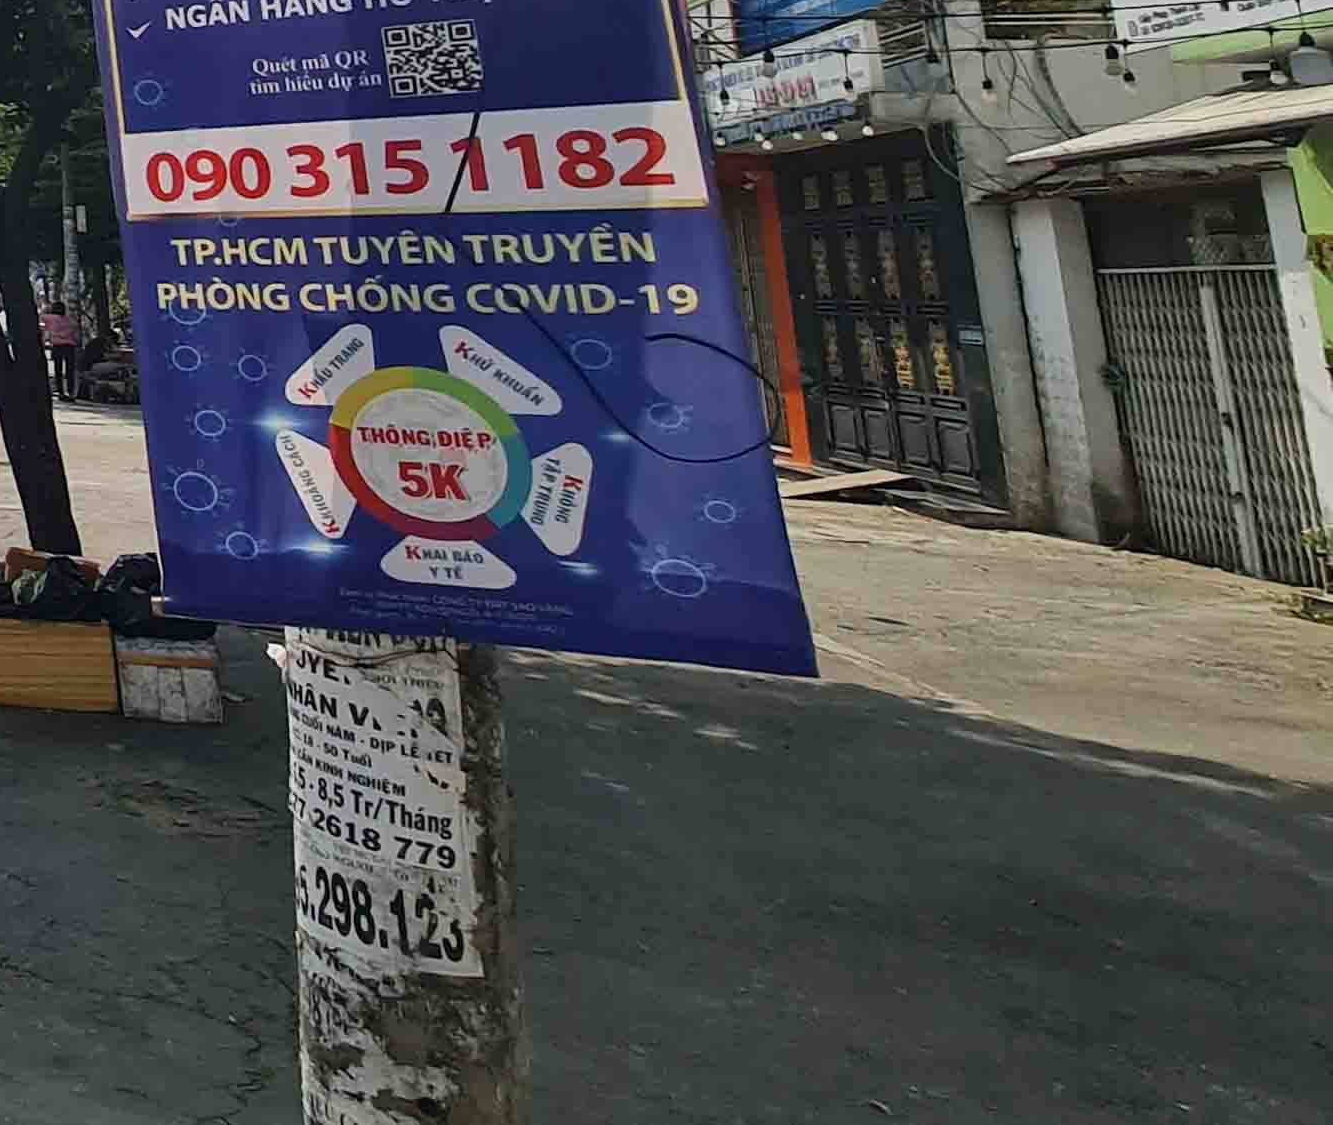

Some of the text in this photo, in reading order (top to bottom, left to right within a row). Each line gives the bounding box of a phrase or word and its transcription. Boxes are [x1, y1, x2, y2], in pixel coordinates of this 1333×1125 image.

[333, 49, 370, 69] QR
[357, 71, 383, 87] án
[145, 125, 676, 203] 090 315 1182
[170, 222, 658, 268] TP.HCM TUYÊN TRUYỀN
[156, 274, 701, 317] PHÒNG CHỐNG COVID-19
[328, 337, 366, 371] TRANG
[356, 423, 431, 448] THÔNG
[397, 460, 469, 502] 5K
[530, 484, 553, 527] TRUNG
[404, 544, 485, 565] KHAI BÁO
[428, 565, 439, 579] Y
[342, 747, 373, 769] Tuổi
[369, 735, 395, 756] DỊP
[314, 756, 345, 780] KINH
[346, 768, 407, 799] NGHIỆM
[317, 776, 345, 811] 8,5
[349, 789, 454, 841] Tr/Tháng
[312, 806, 383, 853] 2618
[393, 835, 457, 871] 779
